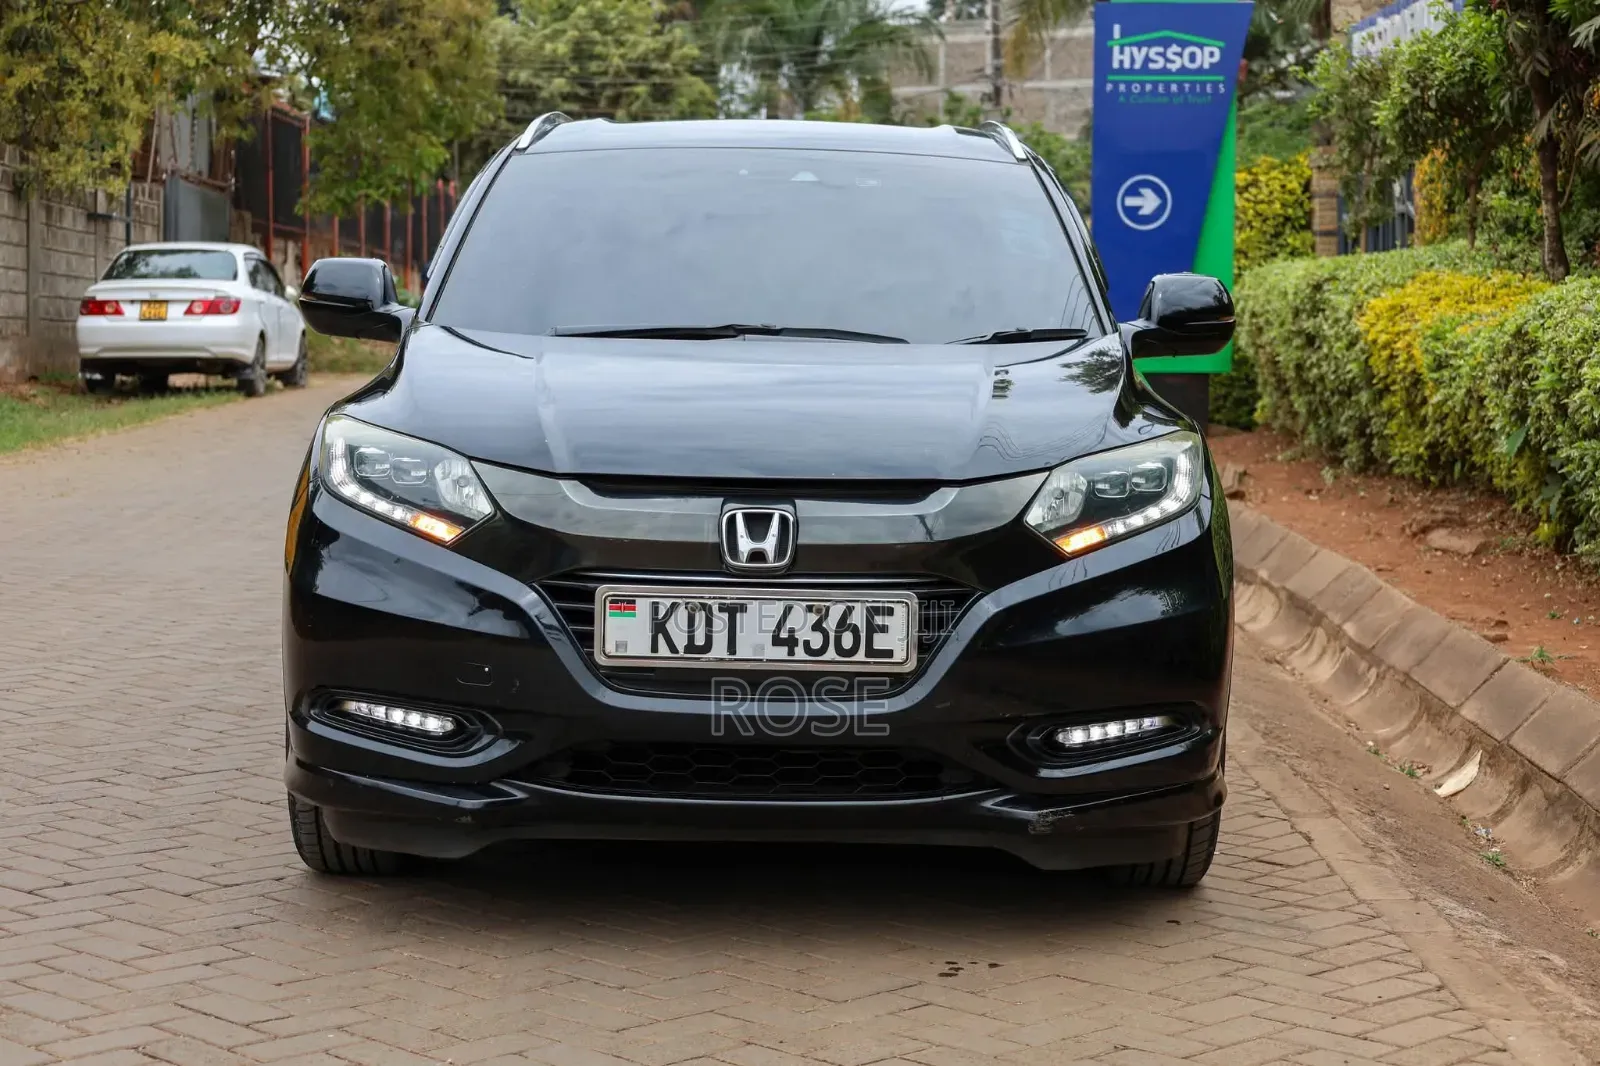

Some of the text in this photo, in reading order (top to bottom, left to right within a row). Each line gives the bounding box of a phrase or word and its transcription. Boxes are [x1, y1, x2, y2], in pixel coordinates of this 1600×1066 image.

[1105, 82, 1226, 94] PROPERTIES
[650, 601, 748, 656] KDT
[771, 603, 895, 659] 436E
